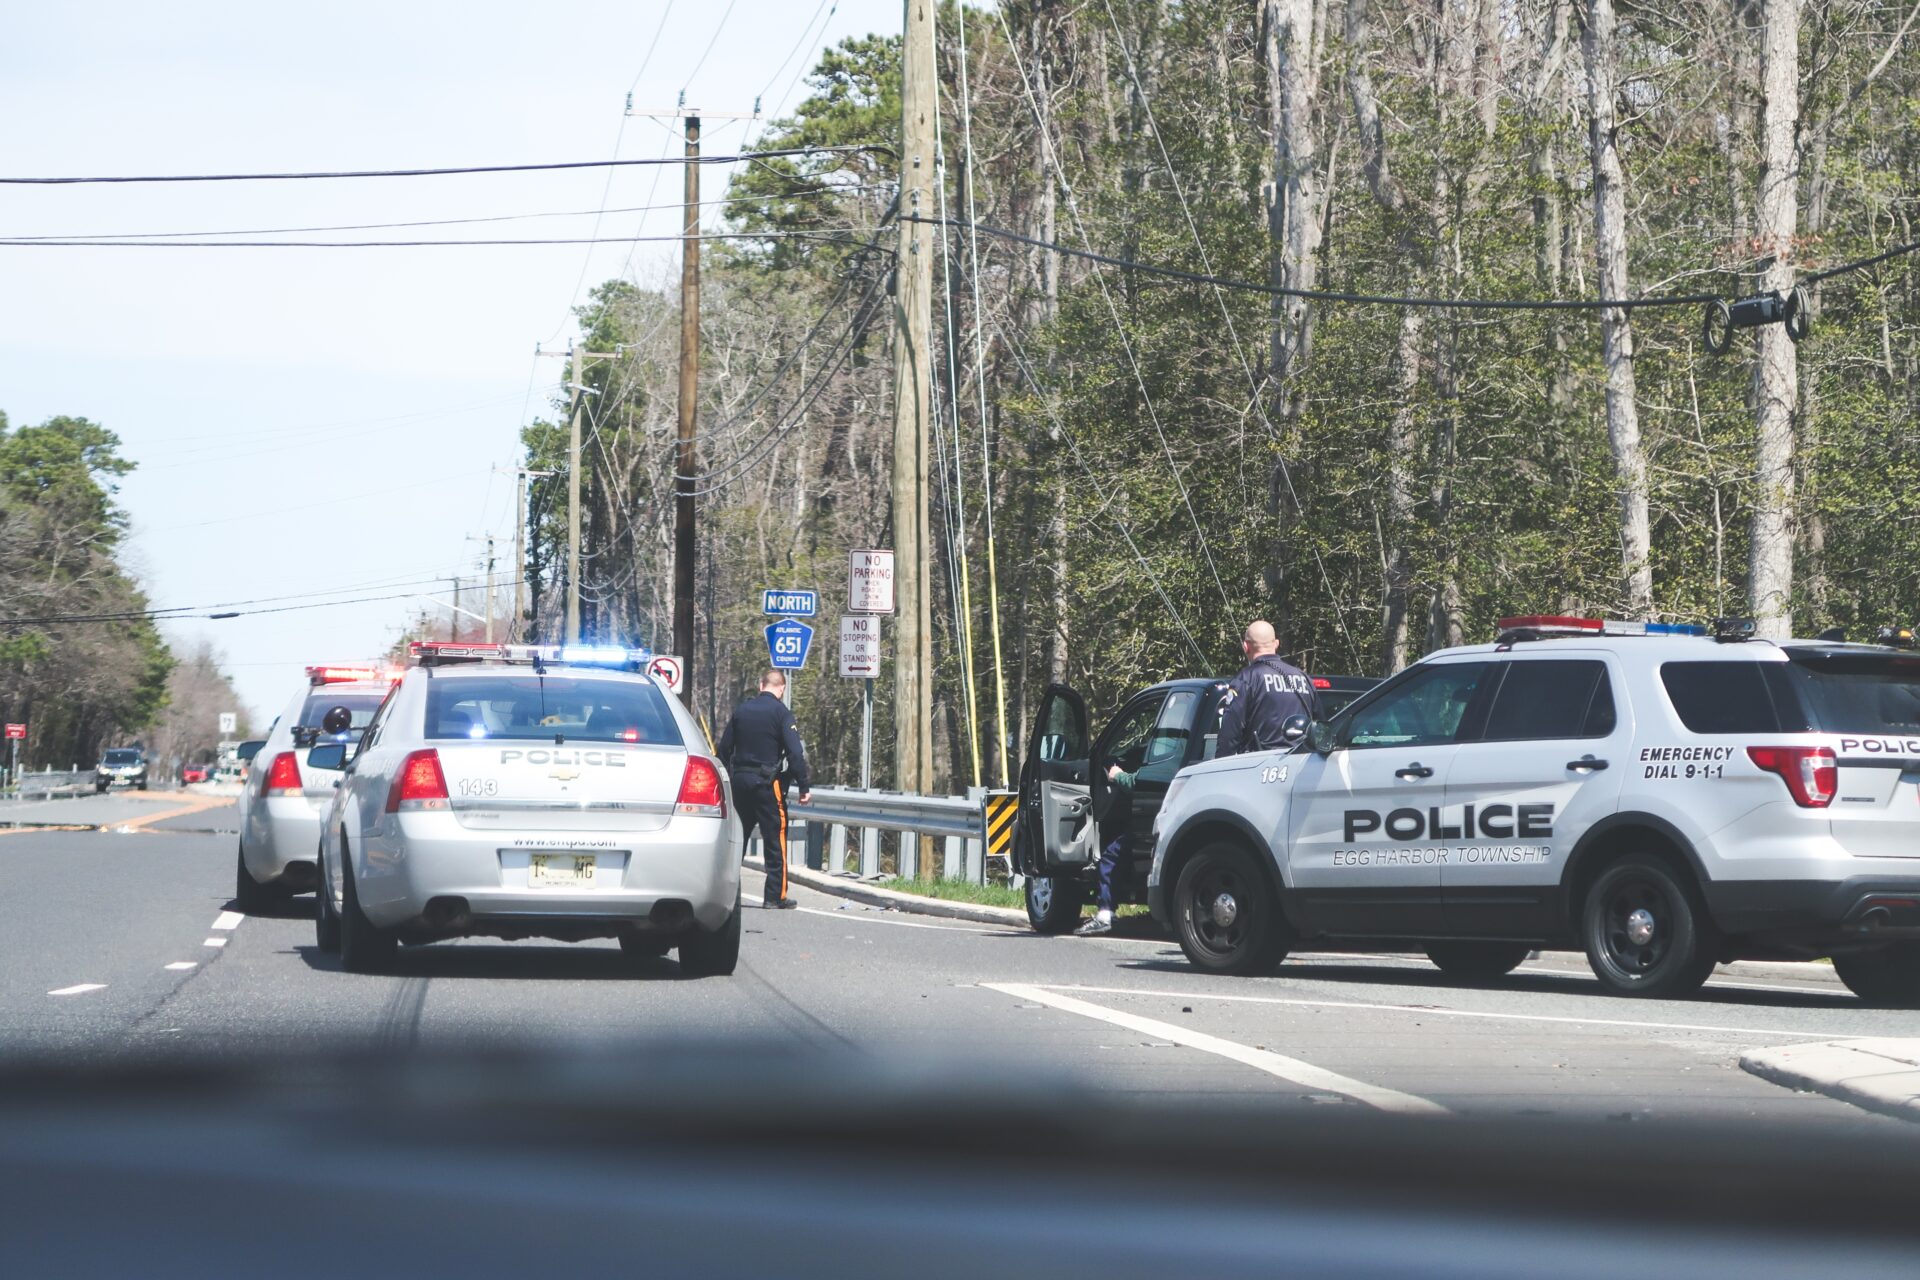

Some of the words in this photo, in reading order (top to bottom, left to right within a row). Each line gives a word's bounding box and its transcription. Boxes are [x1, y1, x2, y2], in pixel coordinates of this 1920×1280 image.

[864, 556, 881, 566] NO
[854, 568, 891, 580] PARKING
[767, 596, 811, 611] NORTH
[852, 620, 868, 632] NO
[843, 633, 877, 642] STOPPING
[775, 637, 802, 654] 651
[855, 644, 865, 653] OR
[843, 654, 877, 663] STANDING
[1264, 673, 1309, 694] POLICE
[500, 750, 626, 767] POLICE
[1640, 746, 1735, 761] EMERGENCY
[1261, 765, 1288, 783] 164
[1644, 764, 1678, 779] DIAL
[1685, 764, 1723, 778] 9-1-1
[458, 778, 498, 796] 143
[1344, 802, 1555, 843] POLICE
[1334, 850, 1370, 866] EGG
[1375, 848, 1449, 865] HARBOR
[1456, 846, 1551, 864] TOWNSHIP
